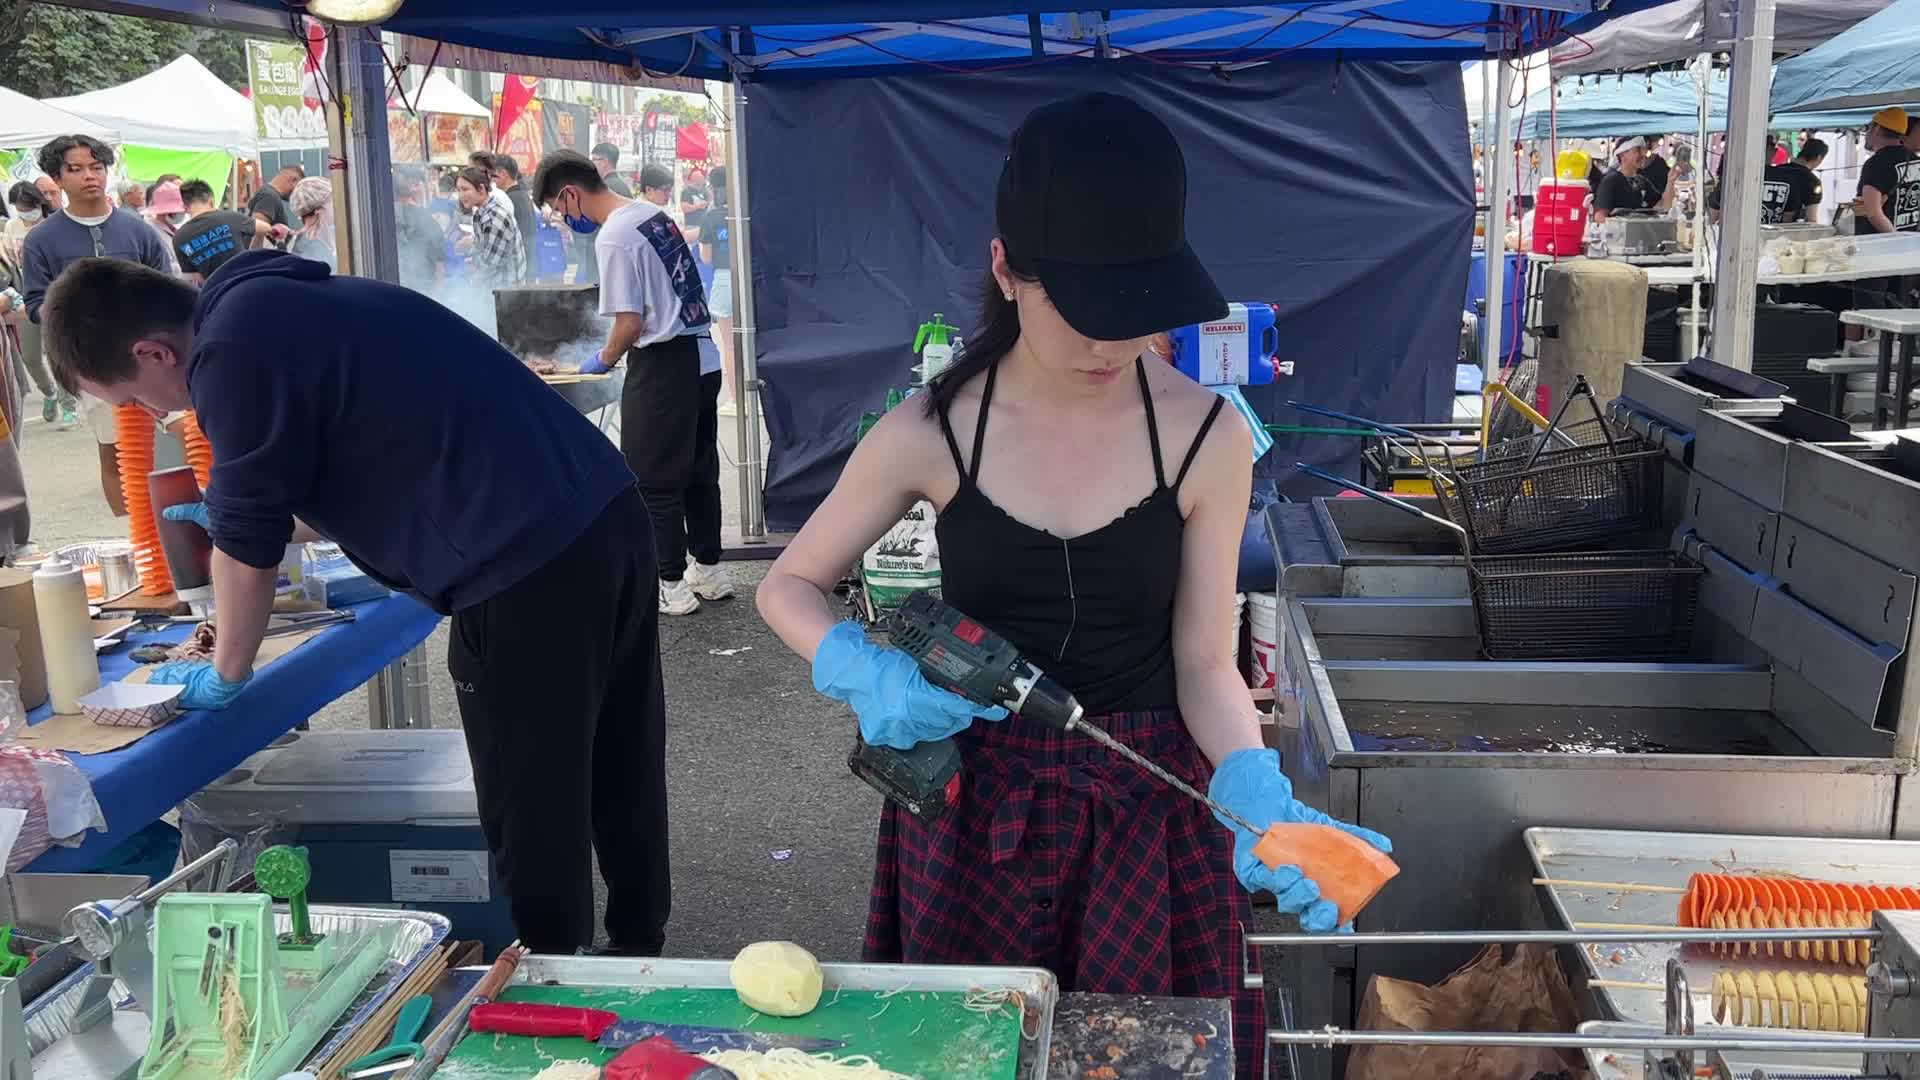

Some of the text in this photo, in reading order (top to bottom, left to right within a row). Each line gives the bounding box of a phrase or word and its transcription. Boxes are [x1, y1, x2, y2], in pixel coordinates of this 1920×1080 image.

[1762, 184, 1787, 204] G'S
[1205, 324, 1242, 333] RELIANCE
[903, 507, 925, 521] coal
